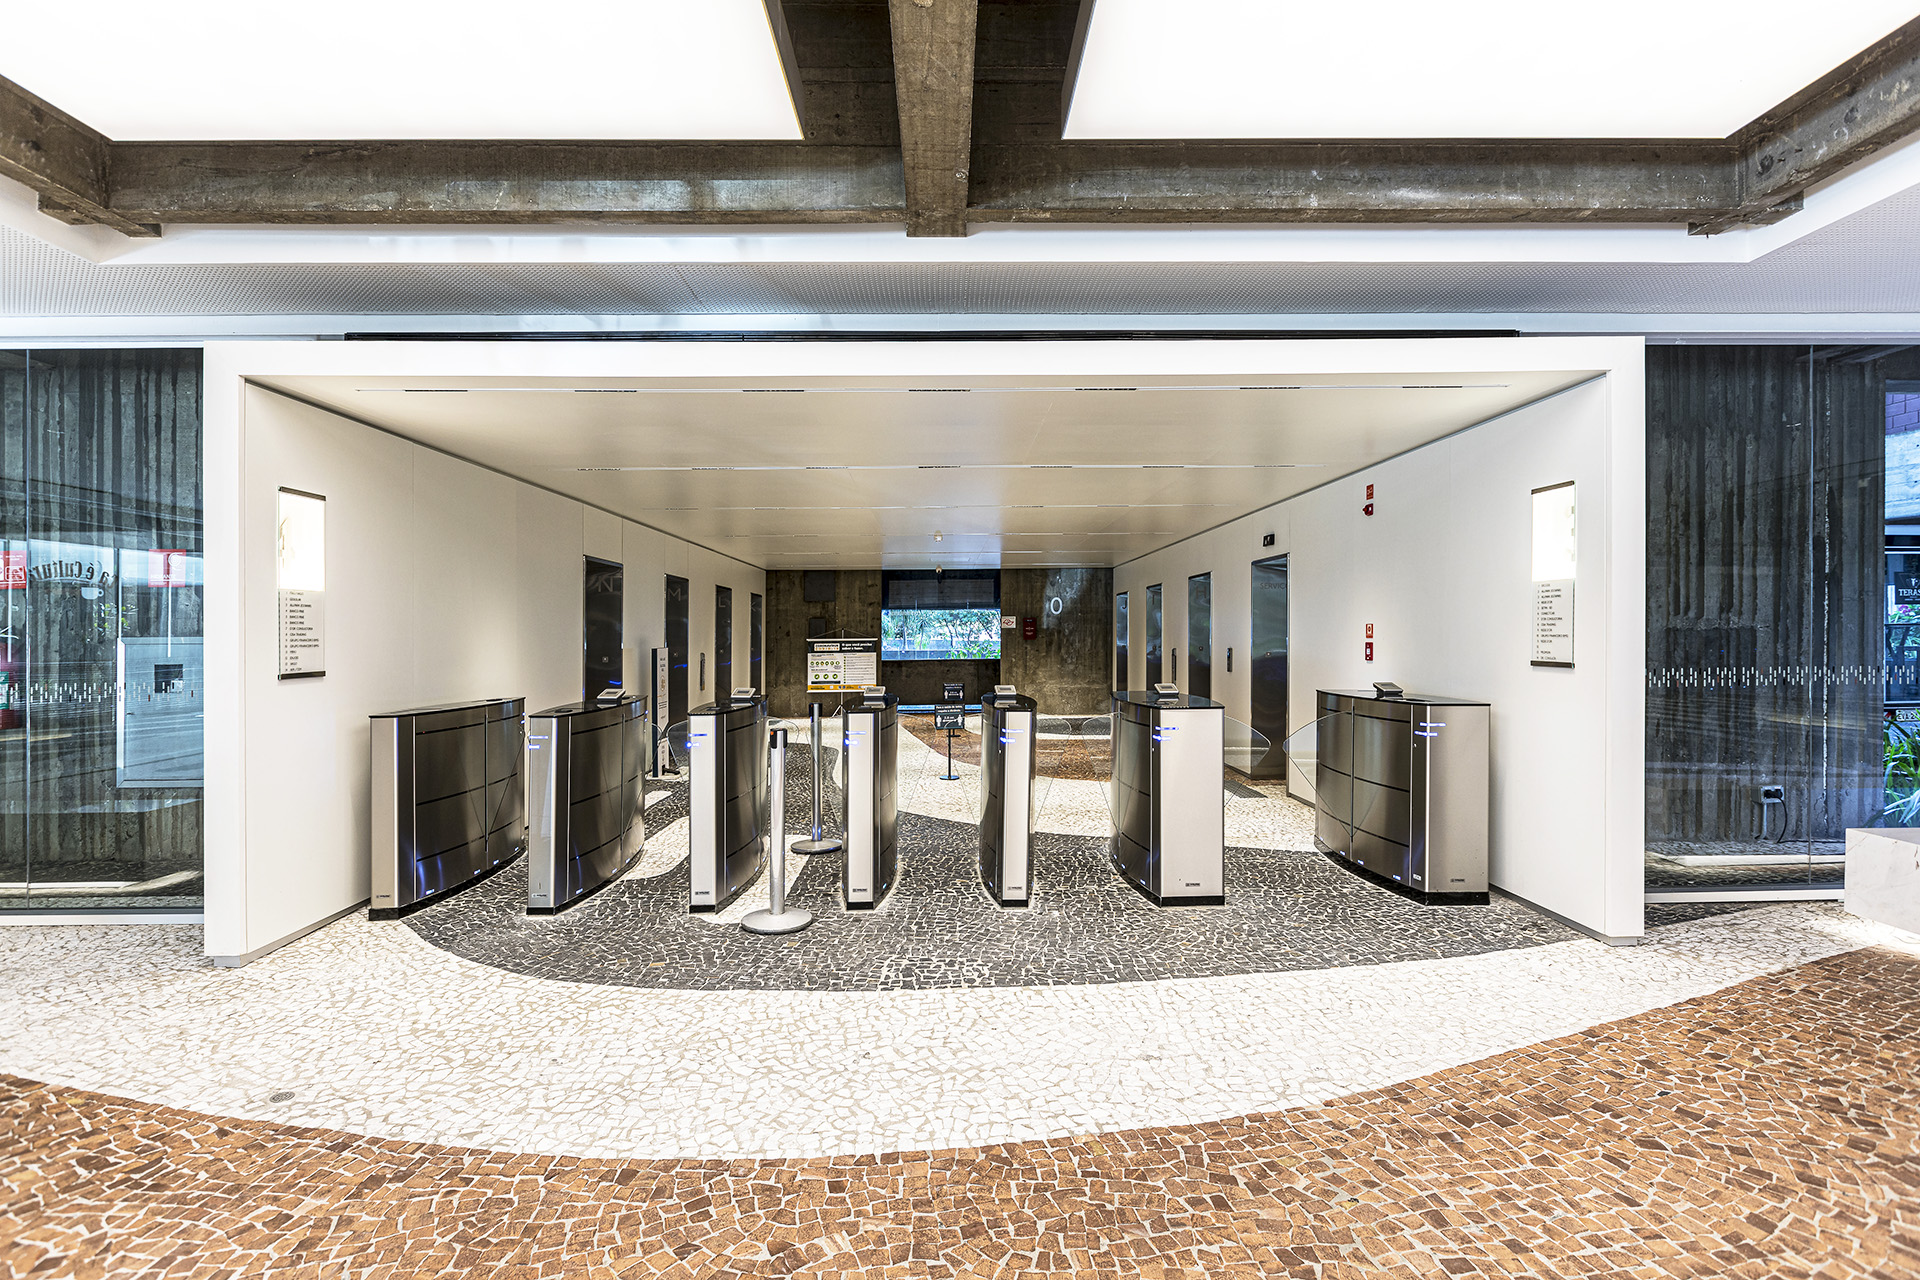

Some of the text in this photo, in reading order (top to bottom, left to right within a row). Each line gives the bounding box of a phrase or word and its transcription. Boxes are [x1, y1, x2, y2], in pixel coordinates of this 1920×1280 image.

[597, 577, 614, 593] N
[667, 588, 681, 602] M
[1195, 586, 1208, 599] H
[718, 596, 727, 608] L
